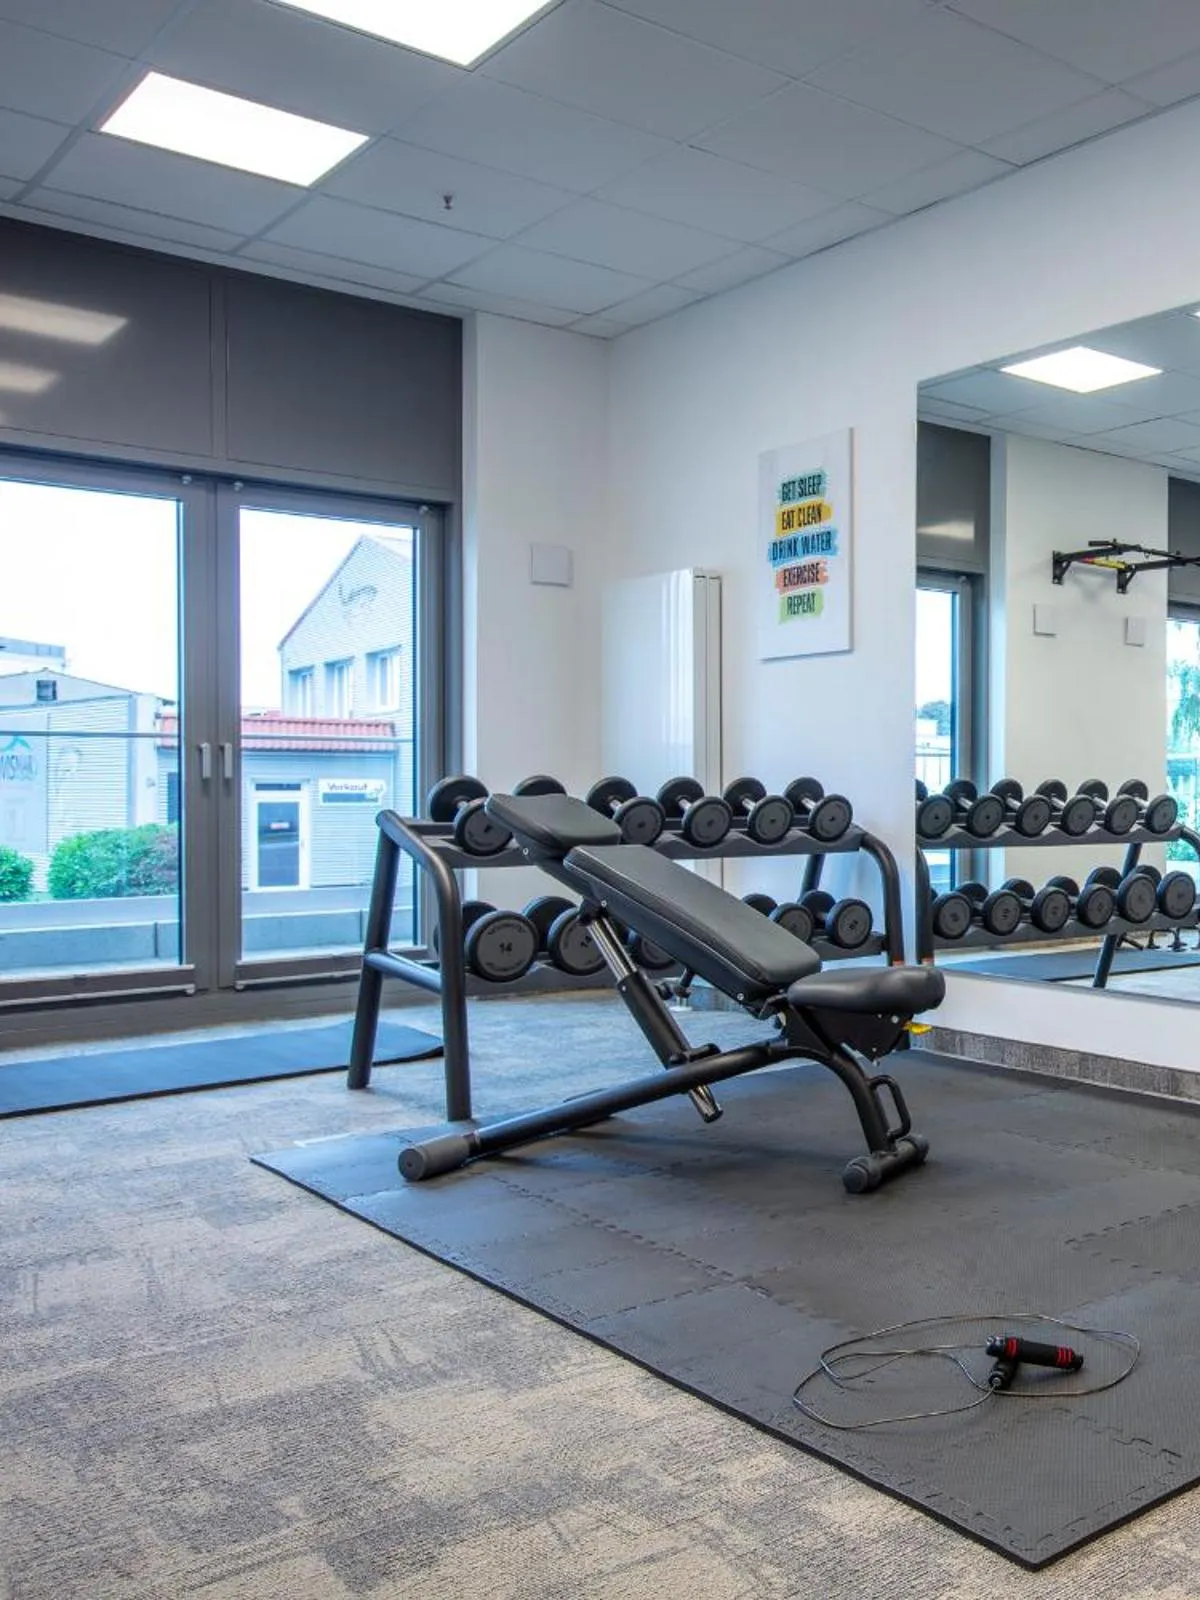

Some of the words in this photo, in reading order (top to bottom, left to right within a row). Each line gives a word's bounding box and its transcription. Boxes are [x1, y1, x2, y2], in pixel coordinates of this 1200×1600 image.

[781, 481, 797, 502] GET
[798, 474, 822, 499] SLEEP
[781, 509, 796, 531] EAT
[798, 503, 822, 527] CLEAN
[771, 538, 799, 561] DRINK
[801, 530, 832, 556] WATER
[783, 562, 820, 588] EXERCISE
[787, 592, 816, 616] REPEAT
